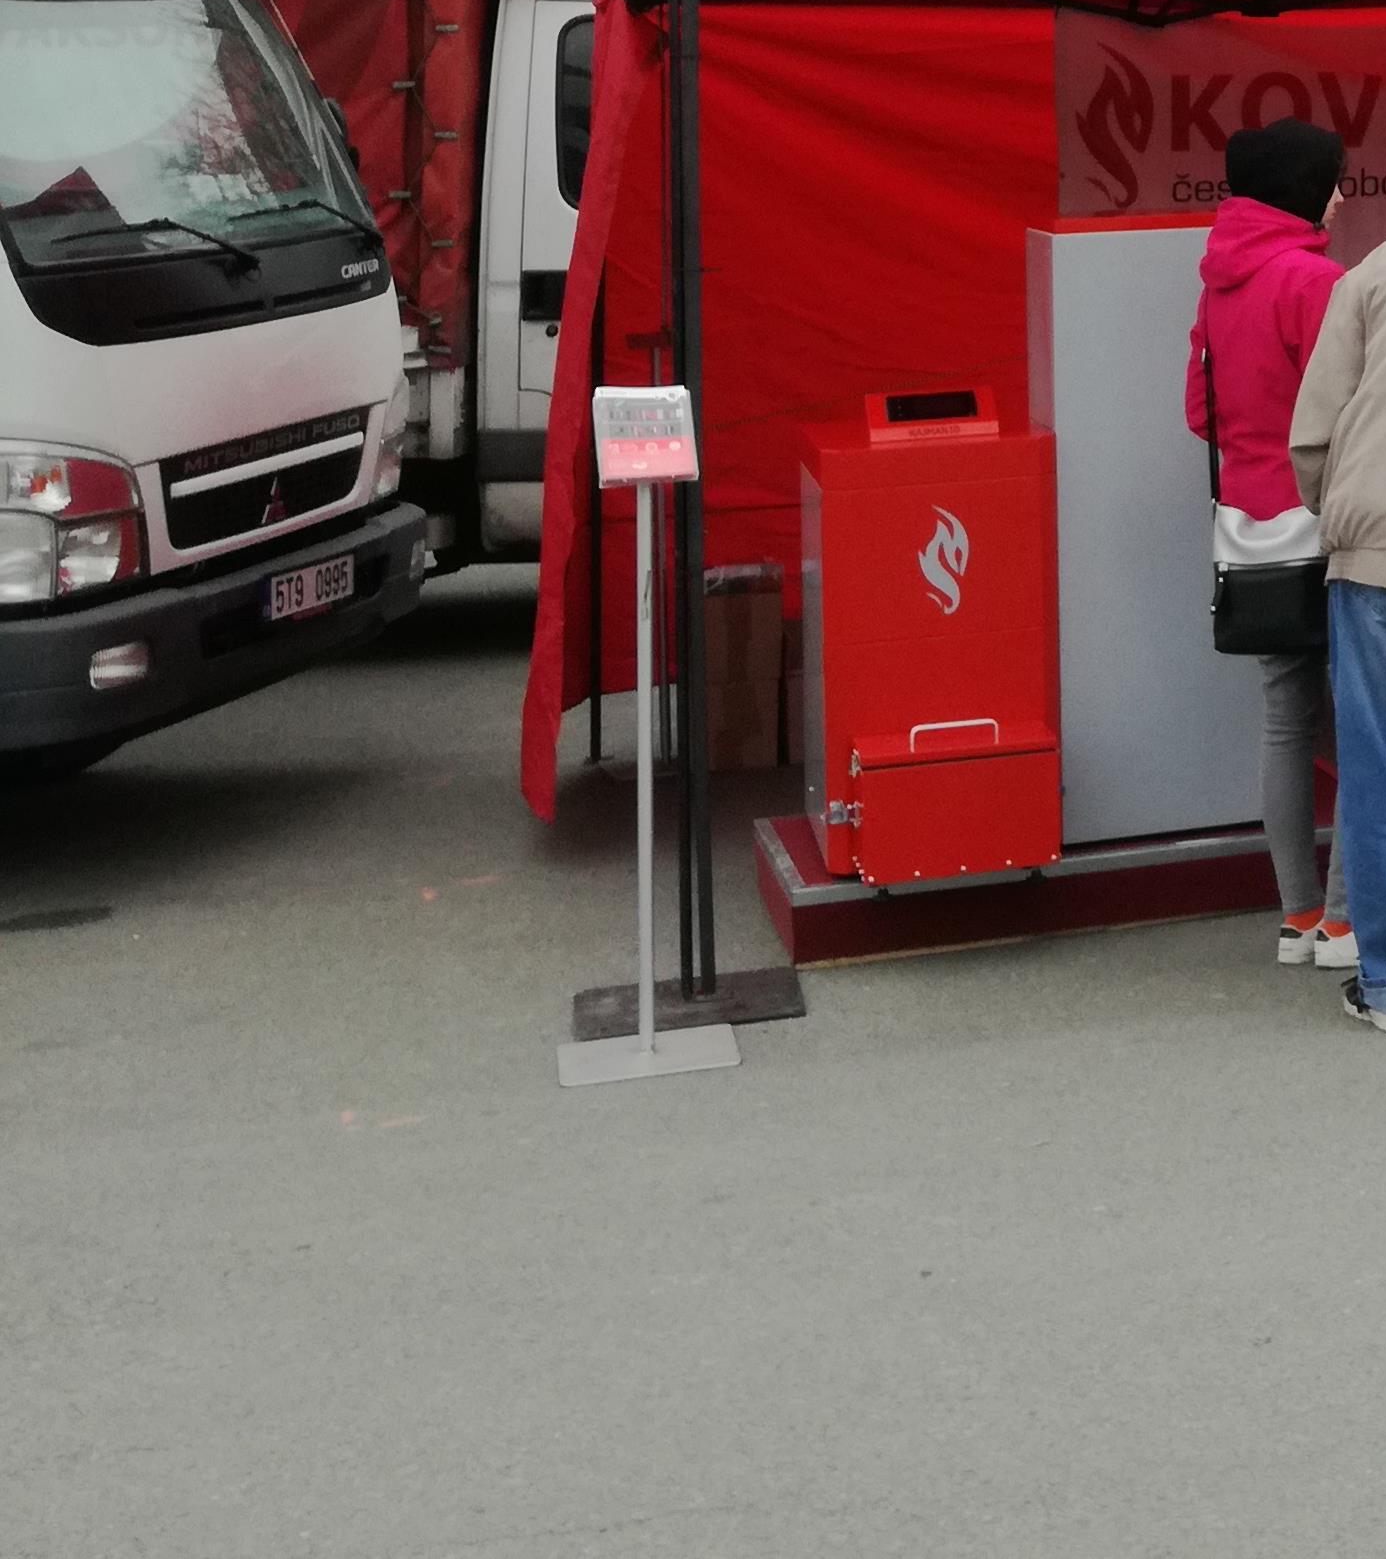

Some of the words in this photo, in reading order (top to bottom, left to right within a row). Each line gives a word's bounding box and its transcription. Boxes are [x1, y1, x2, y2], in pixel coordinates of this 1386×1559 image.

[341, 258, 380, 279] CANTER
[183, 428, 307, 474] MITSUBISHI
[311, 414, 361, 439] FUSO
[275, 573, 305, 613] 5T9
[315, 560, 349, 601] 0995
